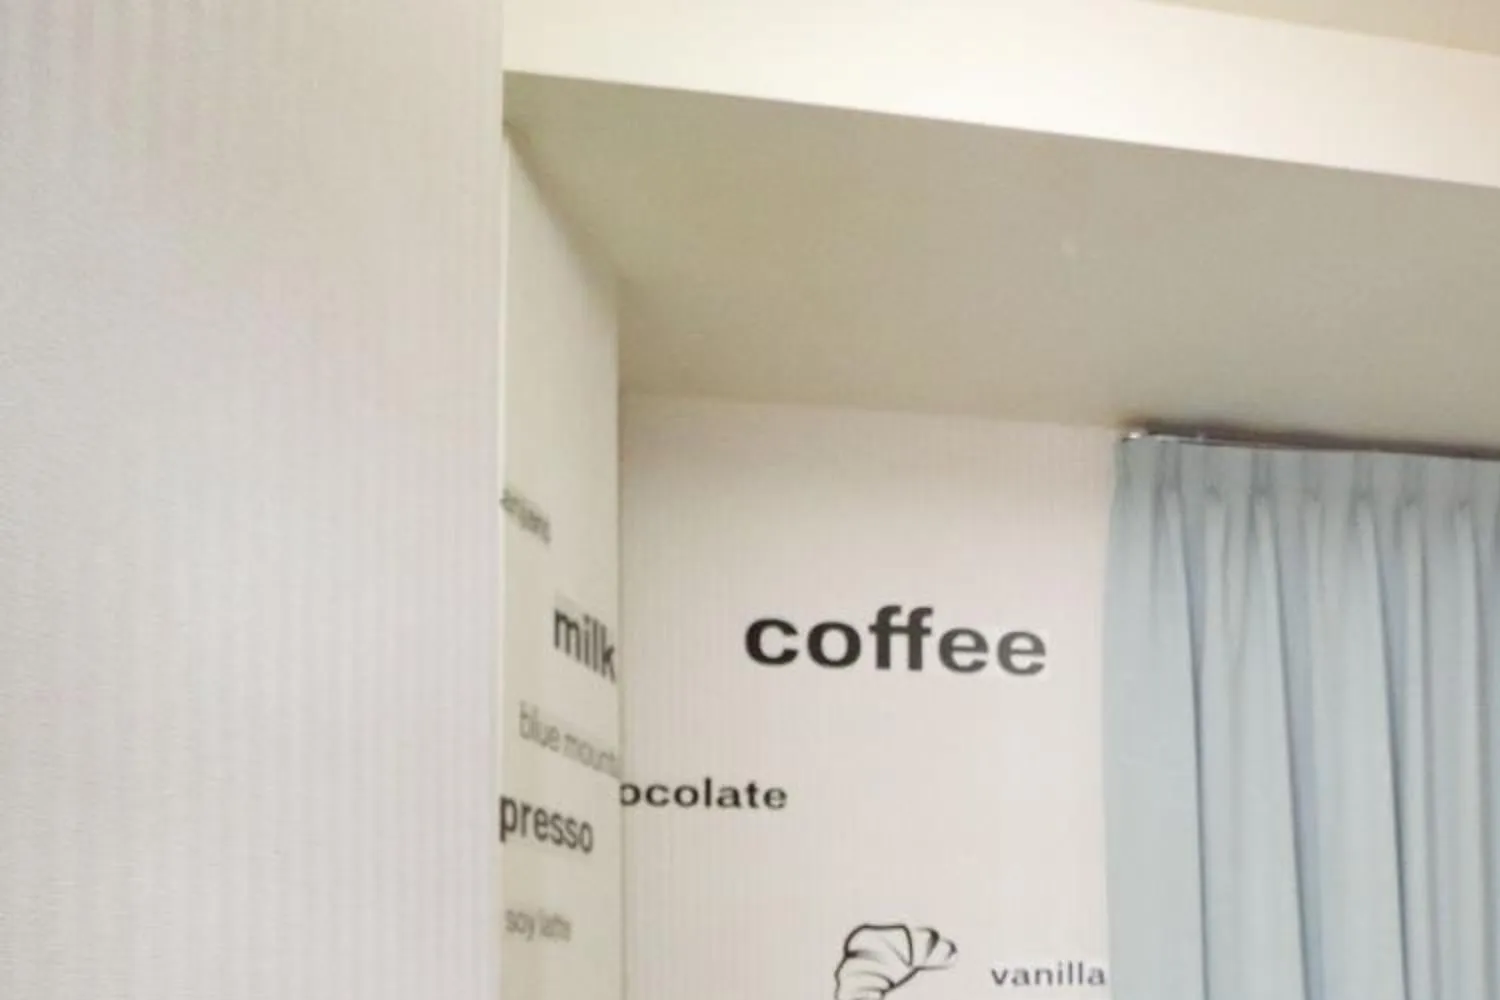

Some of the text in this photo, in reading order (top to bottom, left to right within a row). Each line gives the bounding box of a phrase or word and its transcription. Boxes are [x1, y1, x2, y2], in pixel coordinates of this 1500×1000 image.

[553, 607, 616, 683] milk
[744, 605, 1047, 676] coffee
[519, 700, 561, 754] blue
[620, 777, 788, 810] ocolate
[499, 795, 594, 855] presso
[990, 961, 1107, 988] vanilla
